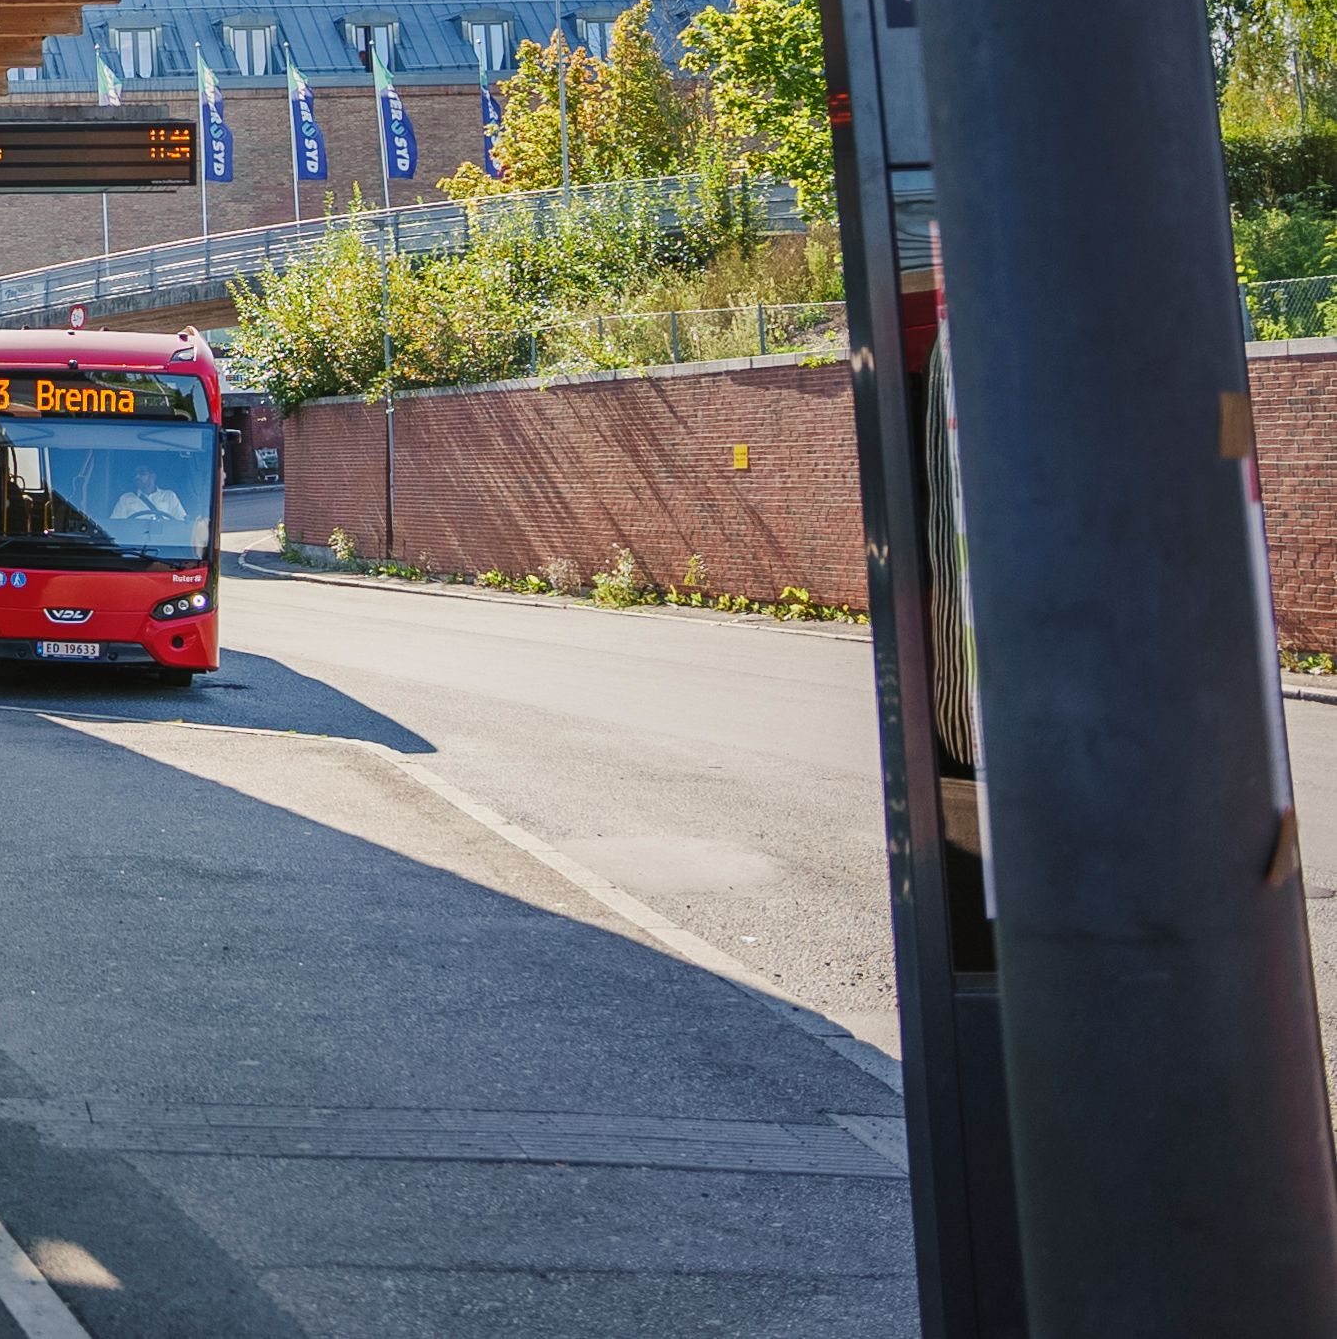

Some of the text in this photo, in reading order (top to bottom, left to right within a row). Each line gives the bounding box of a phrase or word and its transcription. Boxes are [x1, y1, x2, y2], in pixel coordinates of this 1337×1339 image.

[211, 139, 225, 176] SYD
[305, 138, 319, 174] SYD
[394, 135, 410, 172] SYD
[36, 379, 135, 413] Brenna
[52, 609, 85, 619] VDL
[46, 643, 96, 655] ED 19633
